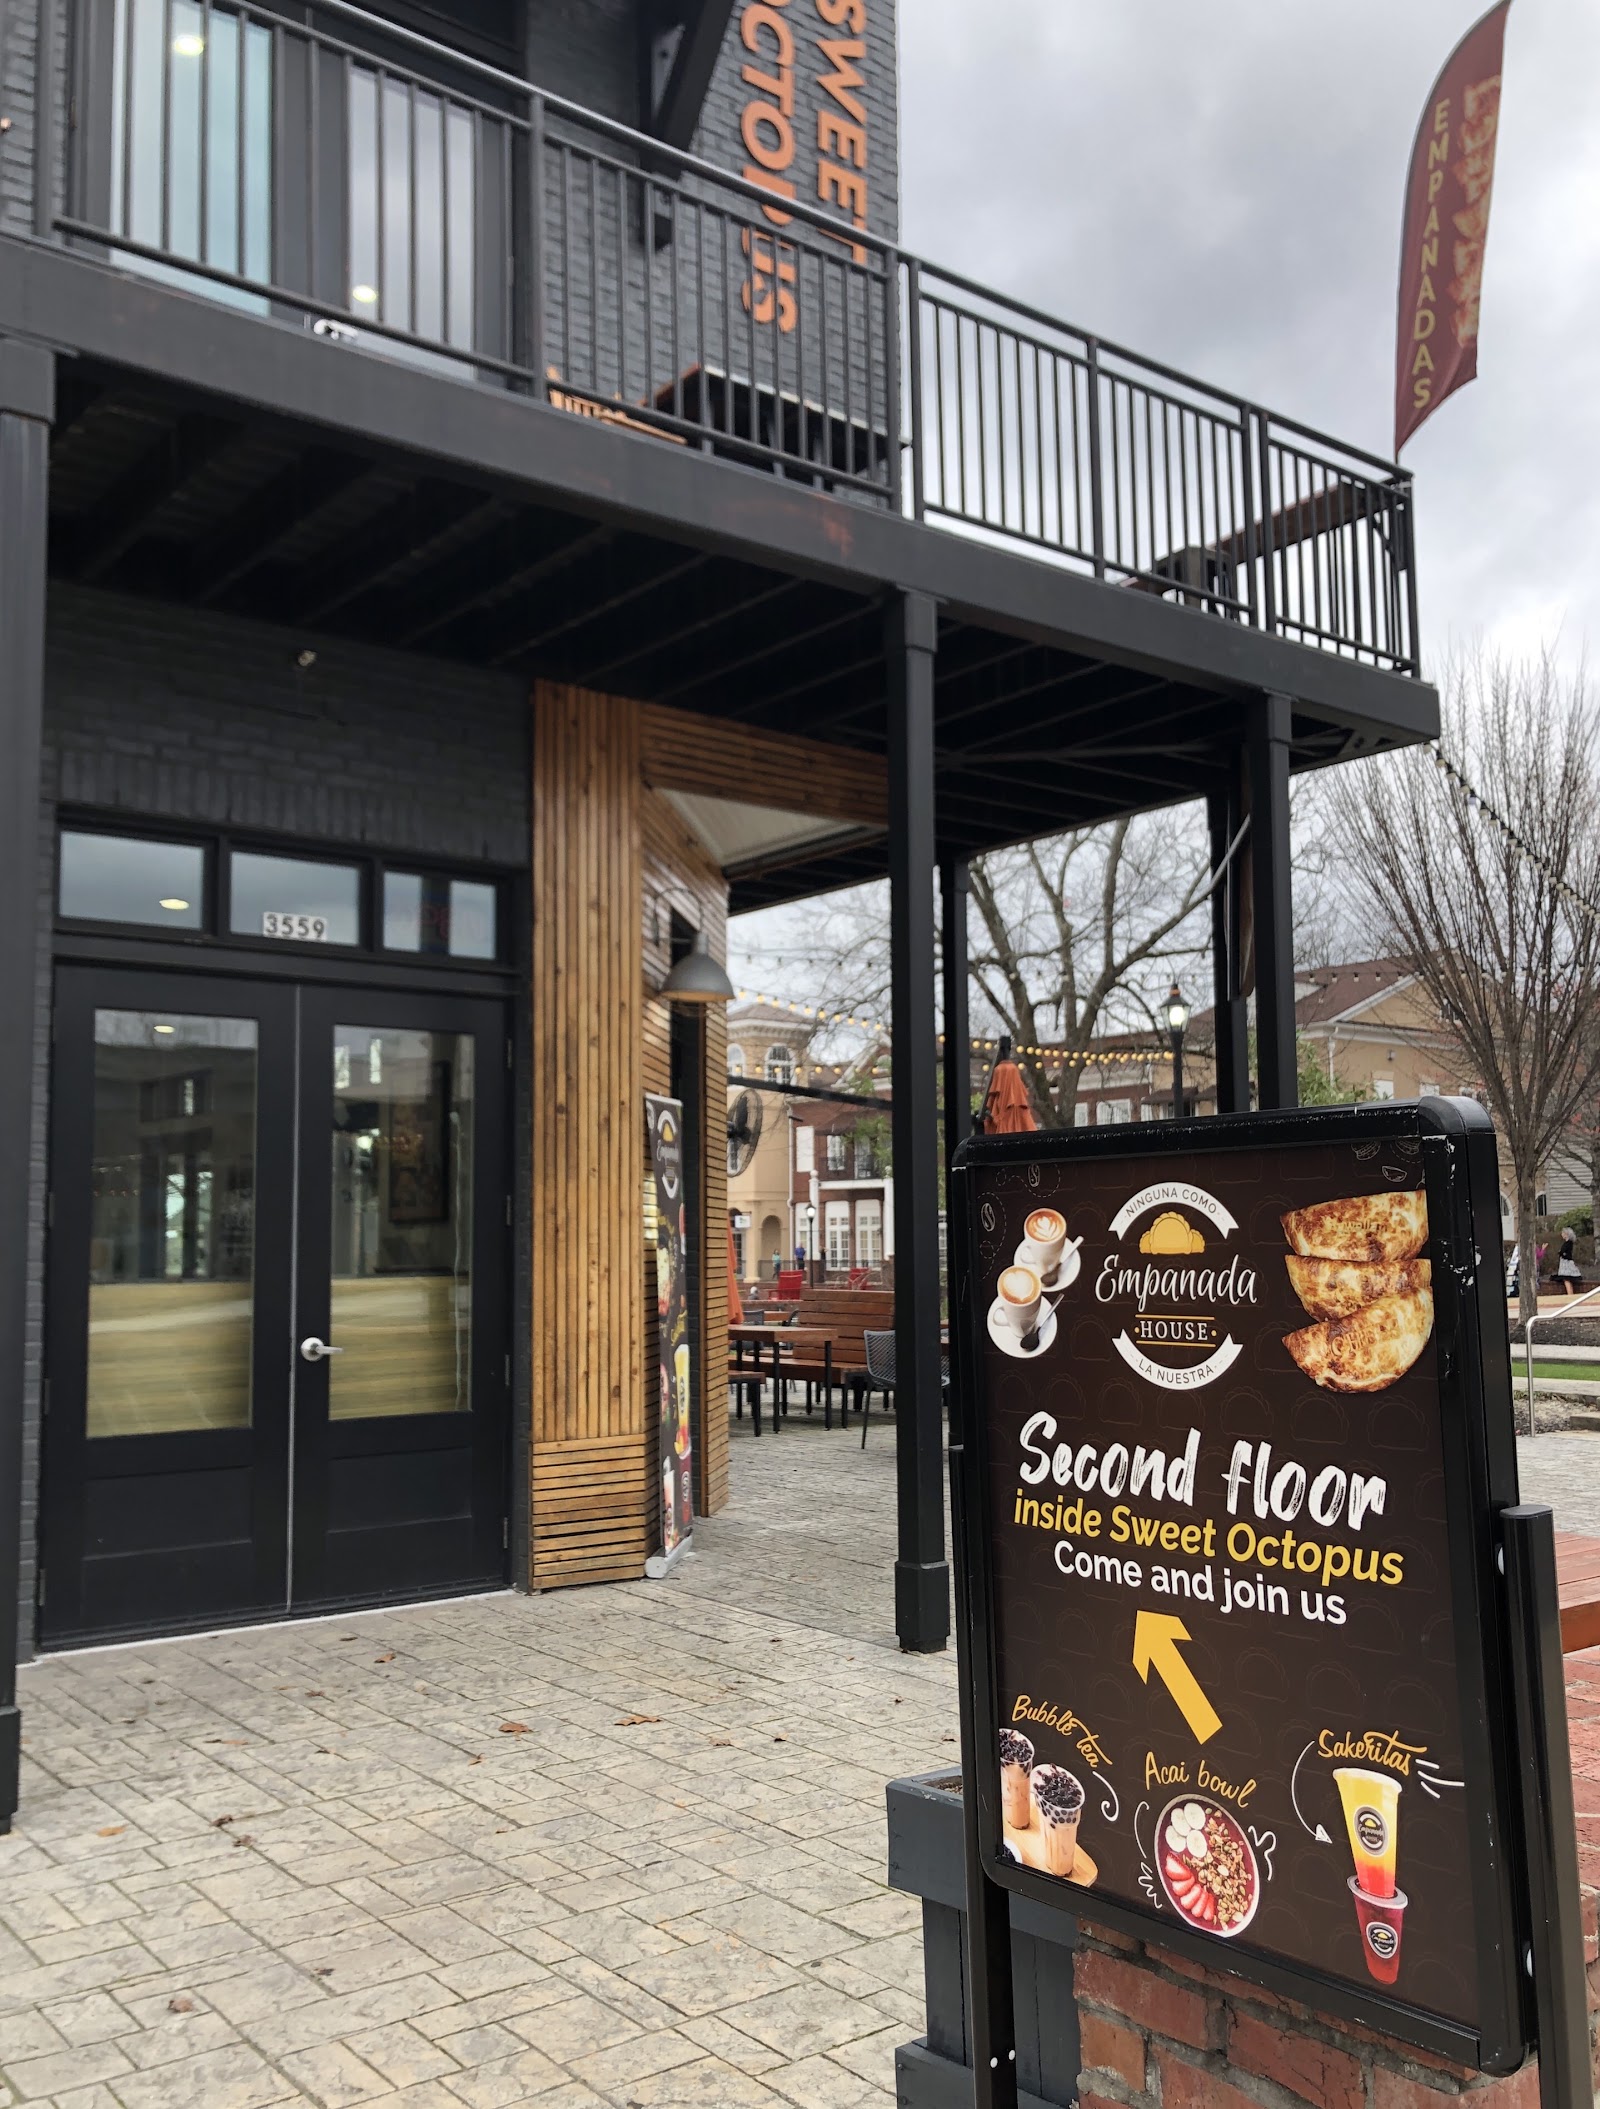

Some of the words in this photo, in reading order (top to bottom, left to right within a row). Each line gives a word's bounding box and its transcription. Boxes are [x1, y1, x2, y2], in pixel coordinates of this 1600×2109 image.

[740, 0, 798, 333] CTOPUS
[1412, 98, 1451, 409] EMPANADAS
[266, 913, 325, 938] 3559
[1124, 1187, 1179, 1217] NINGUNA
[1182, 1188, 1218, 1214] COMO
[1095, 1254, 1258, 1312] Empanada
[1140, 1320, 1208, 1341] HOUSE
[1138, 1358, 1153, 1377] LA
[1156, 1364, 1214, 1384] NUESTRA
[1019, 1410, 1202, 1506] Second
[1221, 1440, 1387, 1531] floor
[1014, 1488, 1102, 1537] inside
[1109, 1505, 1216, 1557] Sweet
[1227, 1522, 1404, 1586] Octopus
[1054, 1540, 1143, 1587] Come
[1150, 1564, 1214, 1602] and
[1220, 1572, 1290, 1614] join
[1300, 1591, 1348, 1625] us
[1011, 1694, 1075, 1737] Bubble
[1072, 1717, 1113, 1768] tea
[1317, 1729, 1428, 1776] Sakeritas
[1144, 1751, 1190, 1790] Acai
[1197, 1759, 1257, 1808] bowl
